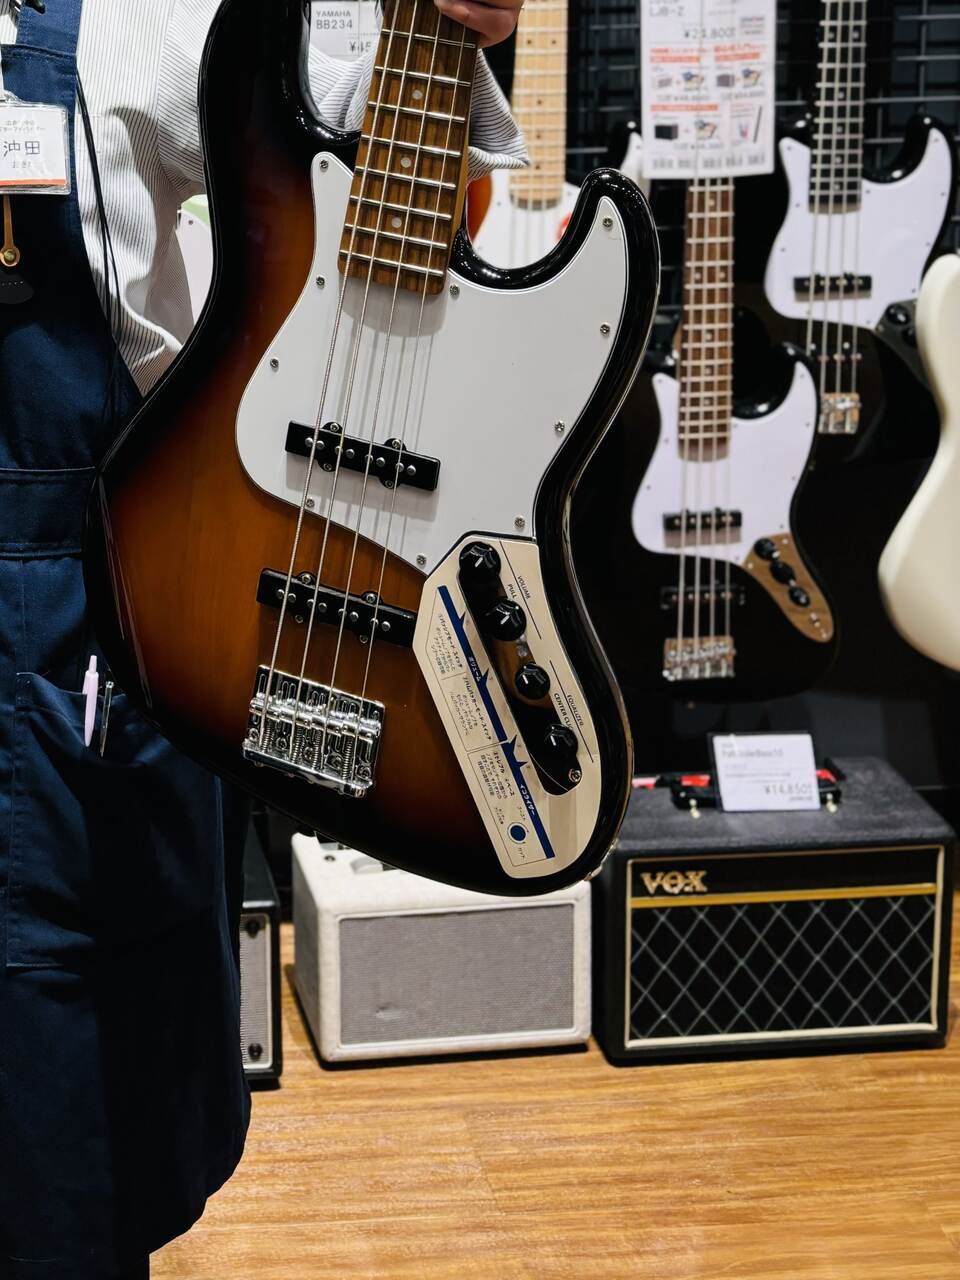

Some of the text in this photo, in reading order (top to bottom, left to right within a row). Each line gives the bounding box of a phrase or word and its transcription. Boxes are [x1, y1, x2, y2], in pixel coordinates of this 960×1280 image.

[316, 19, 353, 30] BB234
[3, 139, 40, 158] 沖田
[507, 583, 518, 599] PULL
[517, 575, 531, 600] VOLUME
[553, 692, 567, 716] CENTER
[519, 783, 535, 815] イコライザー
[641, 871, 708, 894] VOX
